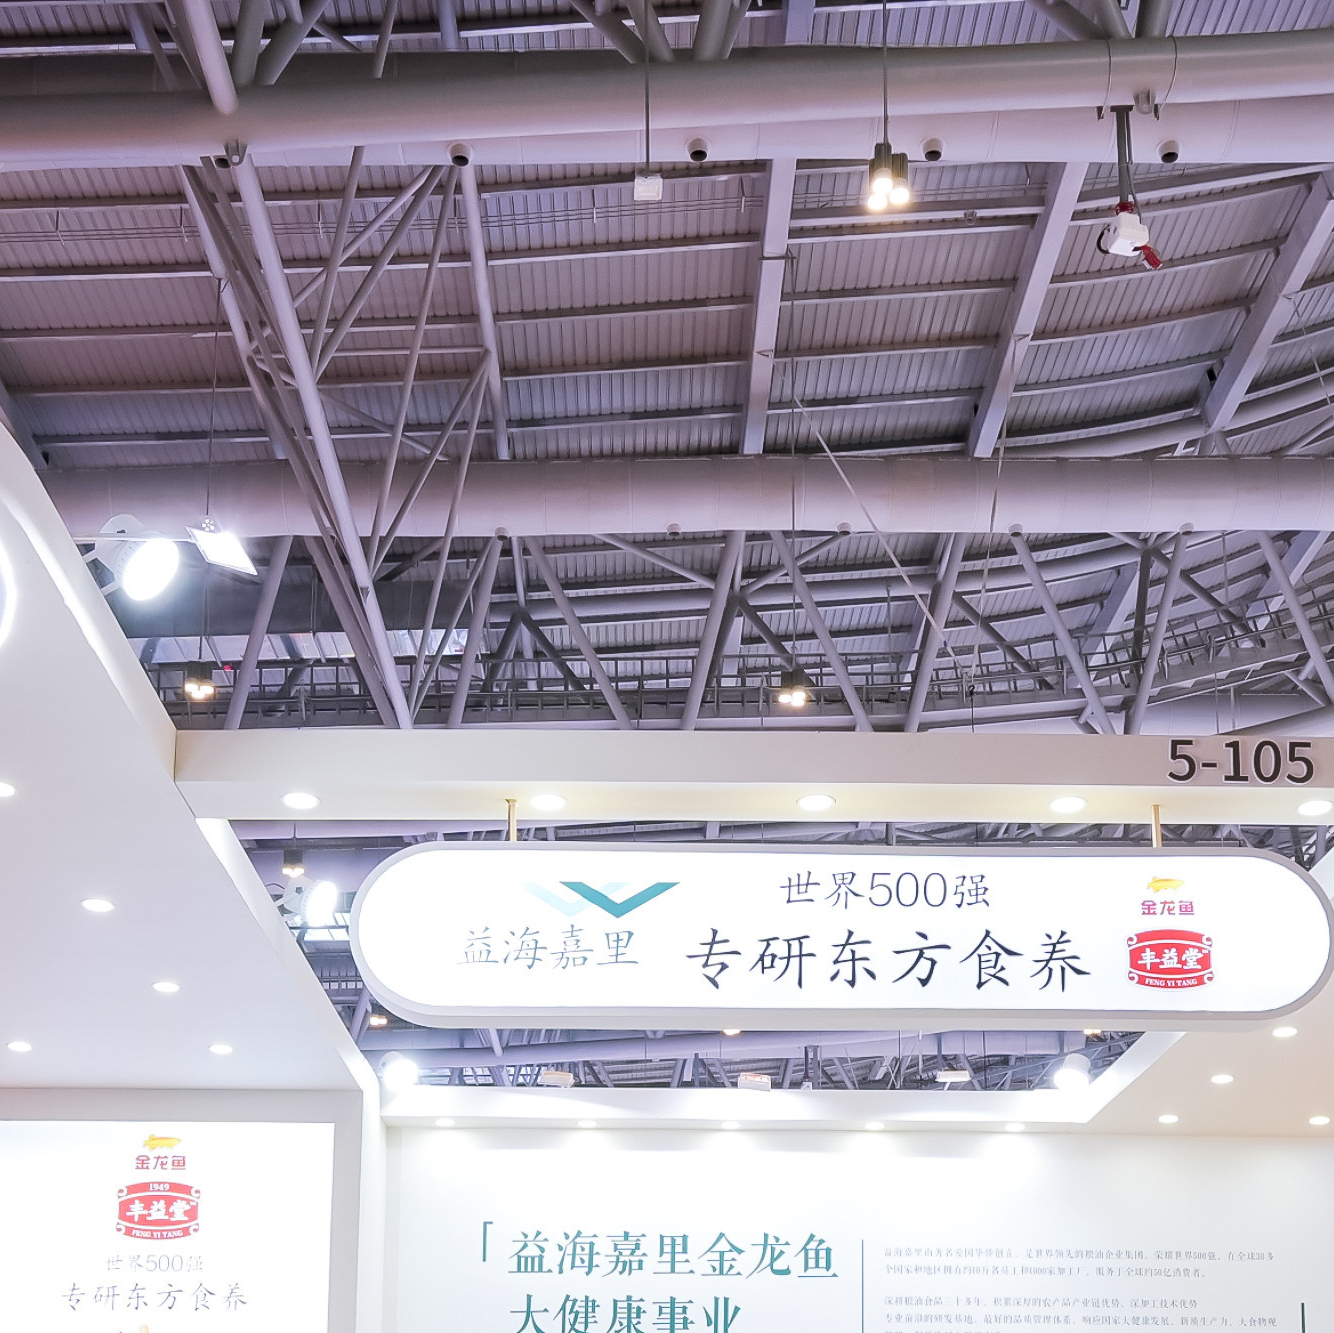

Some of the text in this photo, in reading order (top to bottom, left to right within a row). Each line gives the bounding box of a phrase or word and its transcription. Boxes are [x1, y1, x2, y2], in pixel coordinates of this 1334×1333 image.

[1167, 738, 1315, 784] 5-105
[780, 869, 991, 911] 世界500强
[1140, 900, 1195, 916] 金龙鱼
[456, 924, 640, 972] 益海嘉里
[1137, 947, 1204, 971] 丰益堂
[684, 927, 1092, 993] 专研东方食养
[1144, 978, 1166, 986] FENG
[1176, 978, 1198, 986] TANG
[135, 1155, 186, 1171] 金龙鱼
[149, 1182, 170, 1192] 1949
[125, 1199, 191, 1222] 丰益堂
[105, 1254, 204, 1272] 世界500强
[61, 1282, 248, 1312] 专研东方食养
